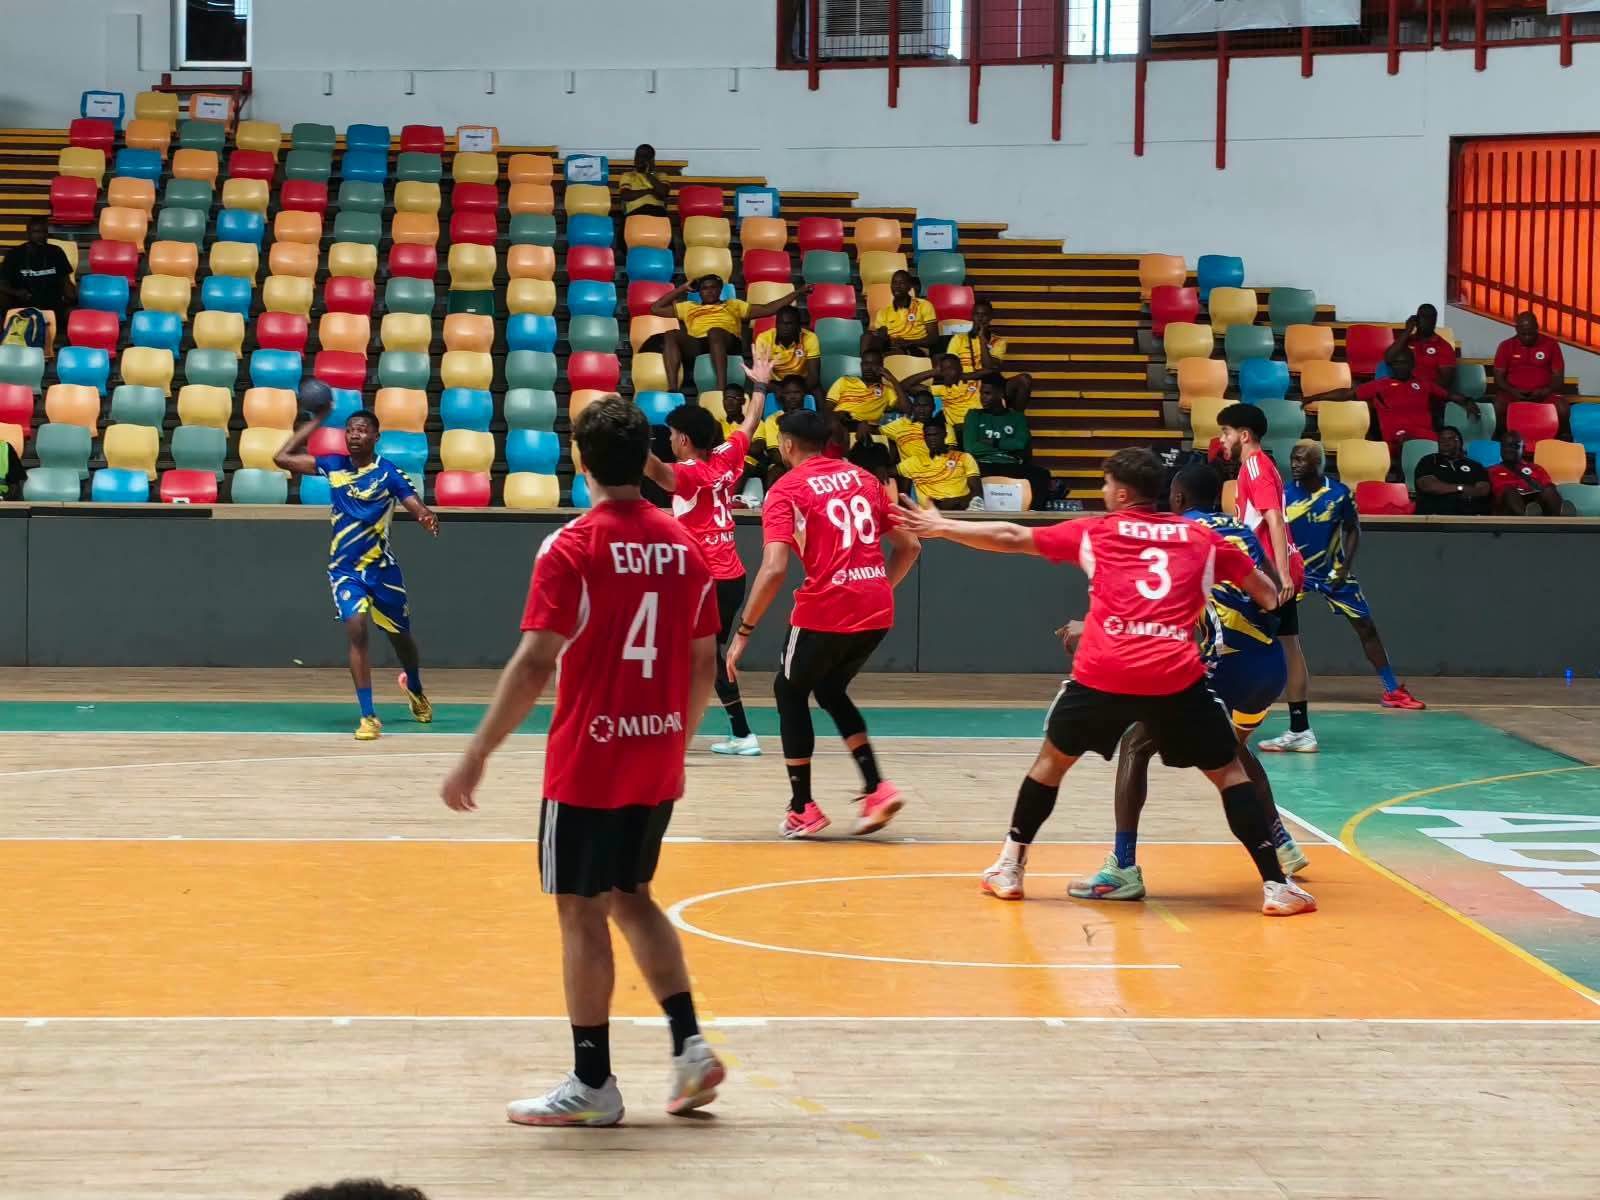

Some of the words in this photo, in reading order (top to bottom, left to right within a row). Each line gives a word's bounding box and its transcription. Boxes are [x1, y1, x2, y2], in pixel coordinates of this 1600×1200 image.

[807, 469, 862, 495] EGYPT
[826, 494, 876, 549] 98
[1117, 520, 1190, 542] EGYPT
[609, 541, 689, 576] EGYPT
[1135, 546, 1172, 601] 3
[622, 591, 658, 679] 4
